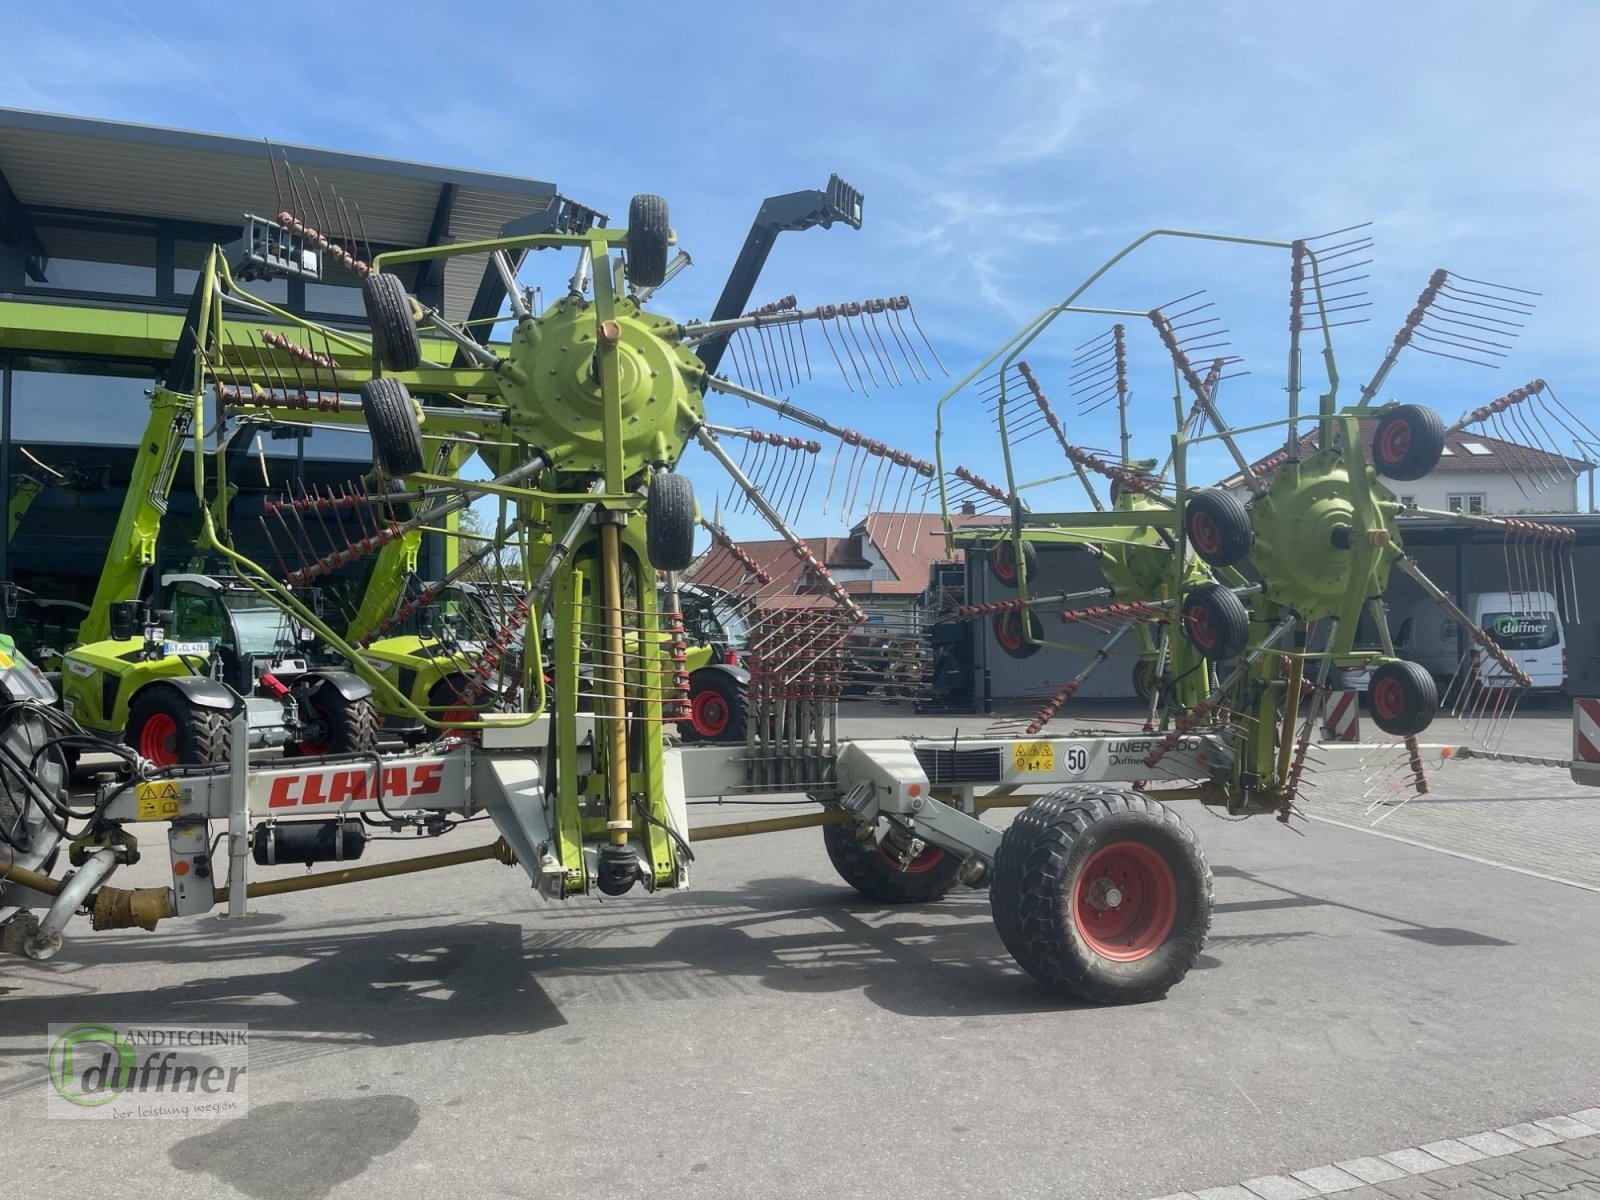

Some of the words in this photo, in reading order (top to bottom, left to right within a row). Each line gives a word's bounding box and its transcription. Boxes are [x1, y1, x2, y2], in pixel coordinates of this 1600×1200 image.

[1503, 621, 1547, 633] duffner
[1108, 741, 1152, 753] LINER
[1068, 750, 1086, 770] 50
[268, 764, 444, 808] CLAAS
